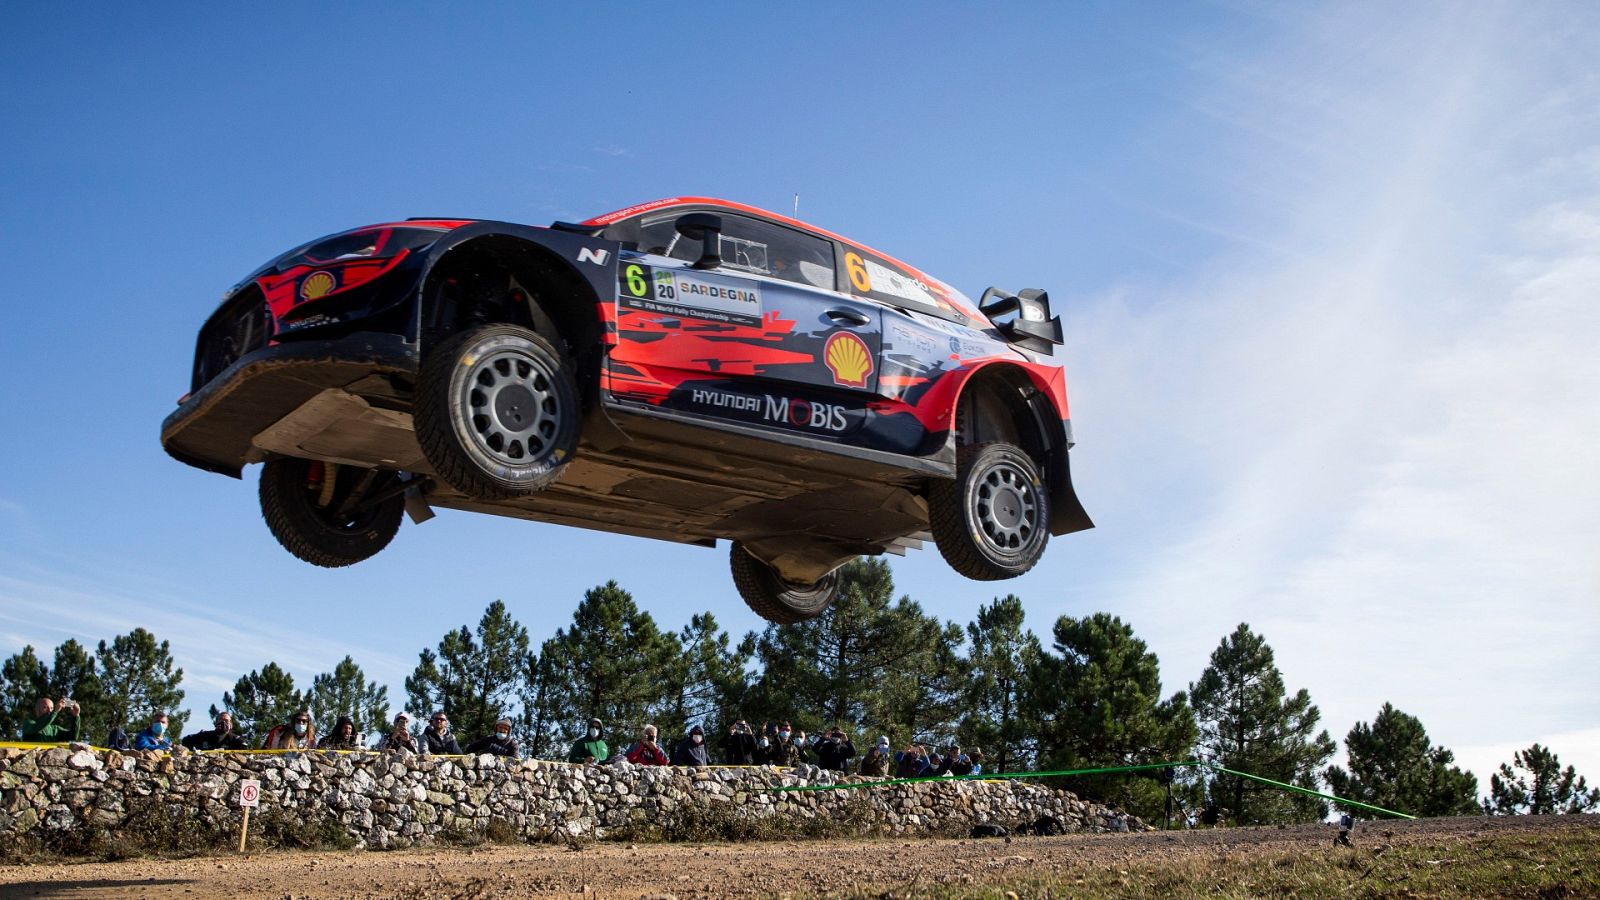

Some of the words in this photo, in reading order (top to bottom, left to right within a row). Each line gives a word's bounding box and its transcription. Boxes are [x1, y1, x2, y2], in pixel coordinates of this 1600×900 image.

[625, 264, 647, 297] 6
[655, 271, 673, 285] 20
[844, 251, 871, 293] 6
[657, 284, 675, 299] 20
[680, 282, 758, 304] SARDEGNA
[656, 304, 674, 313] World
[674, 307, 689, 316] Rally
[689, 309, 730, 322] Championship
[692, 389, 761, 412] HYUNDAI
[763, 394, 848, 432] MOBIS
